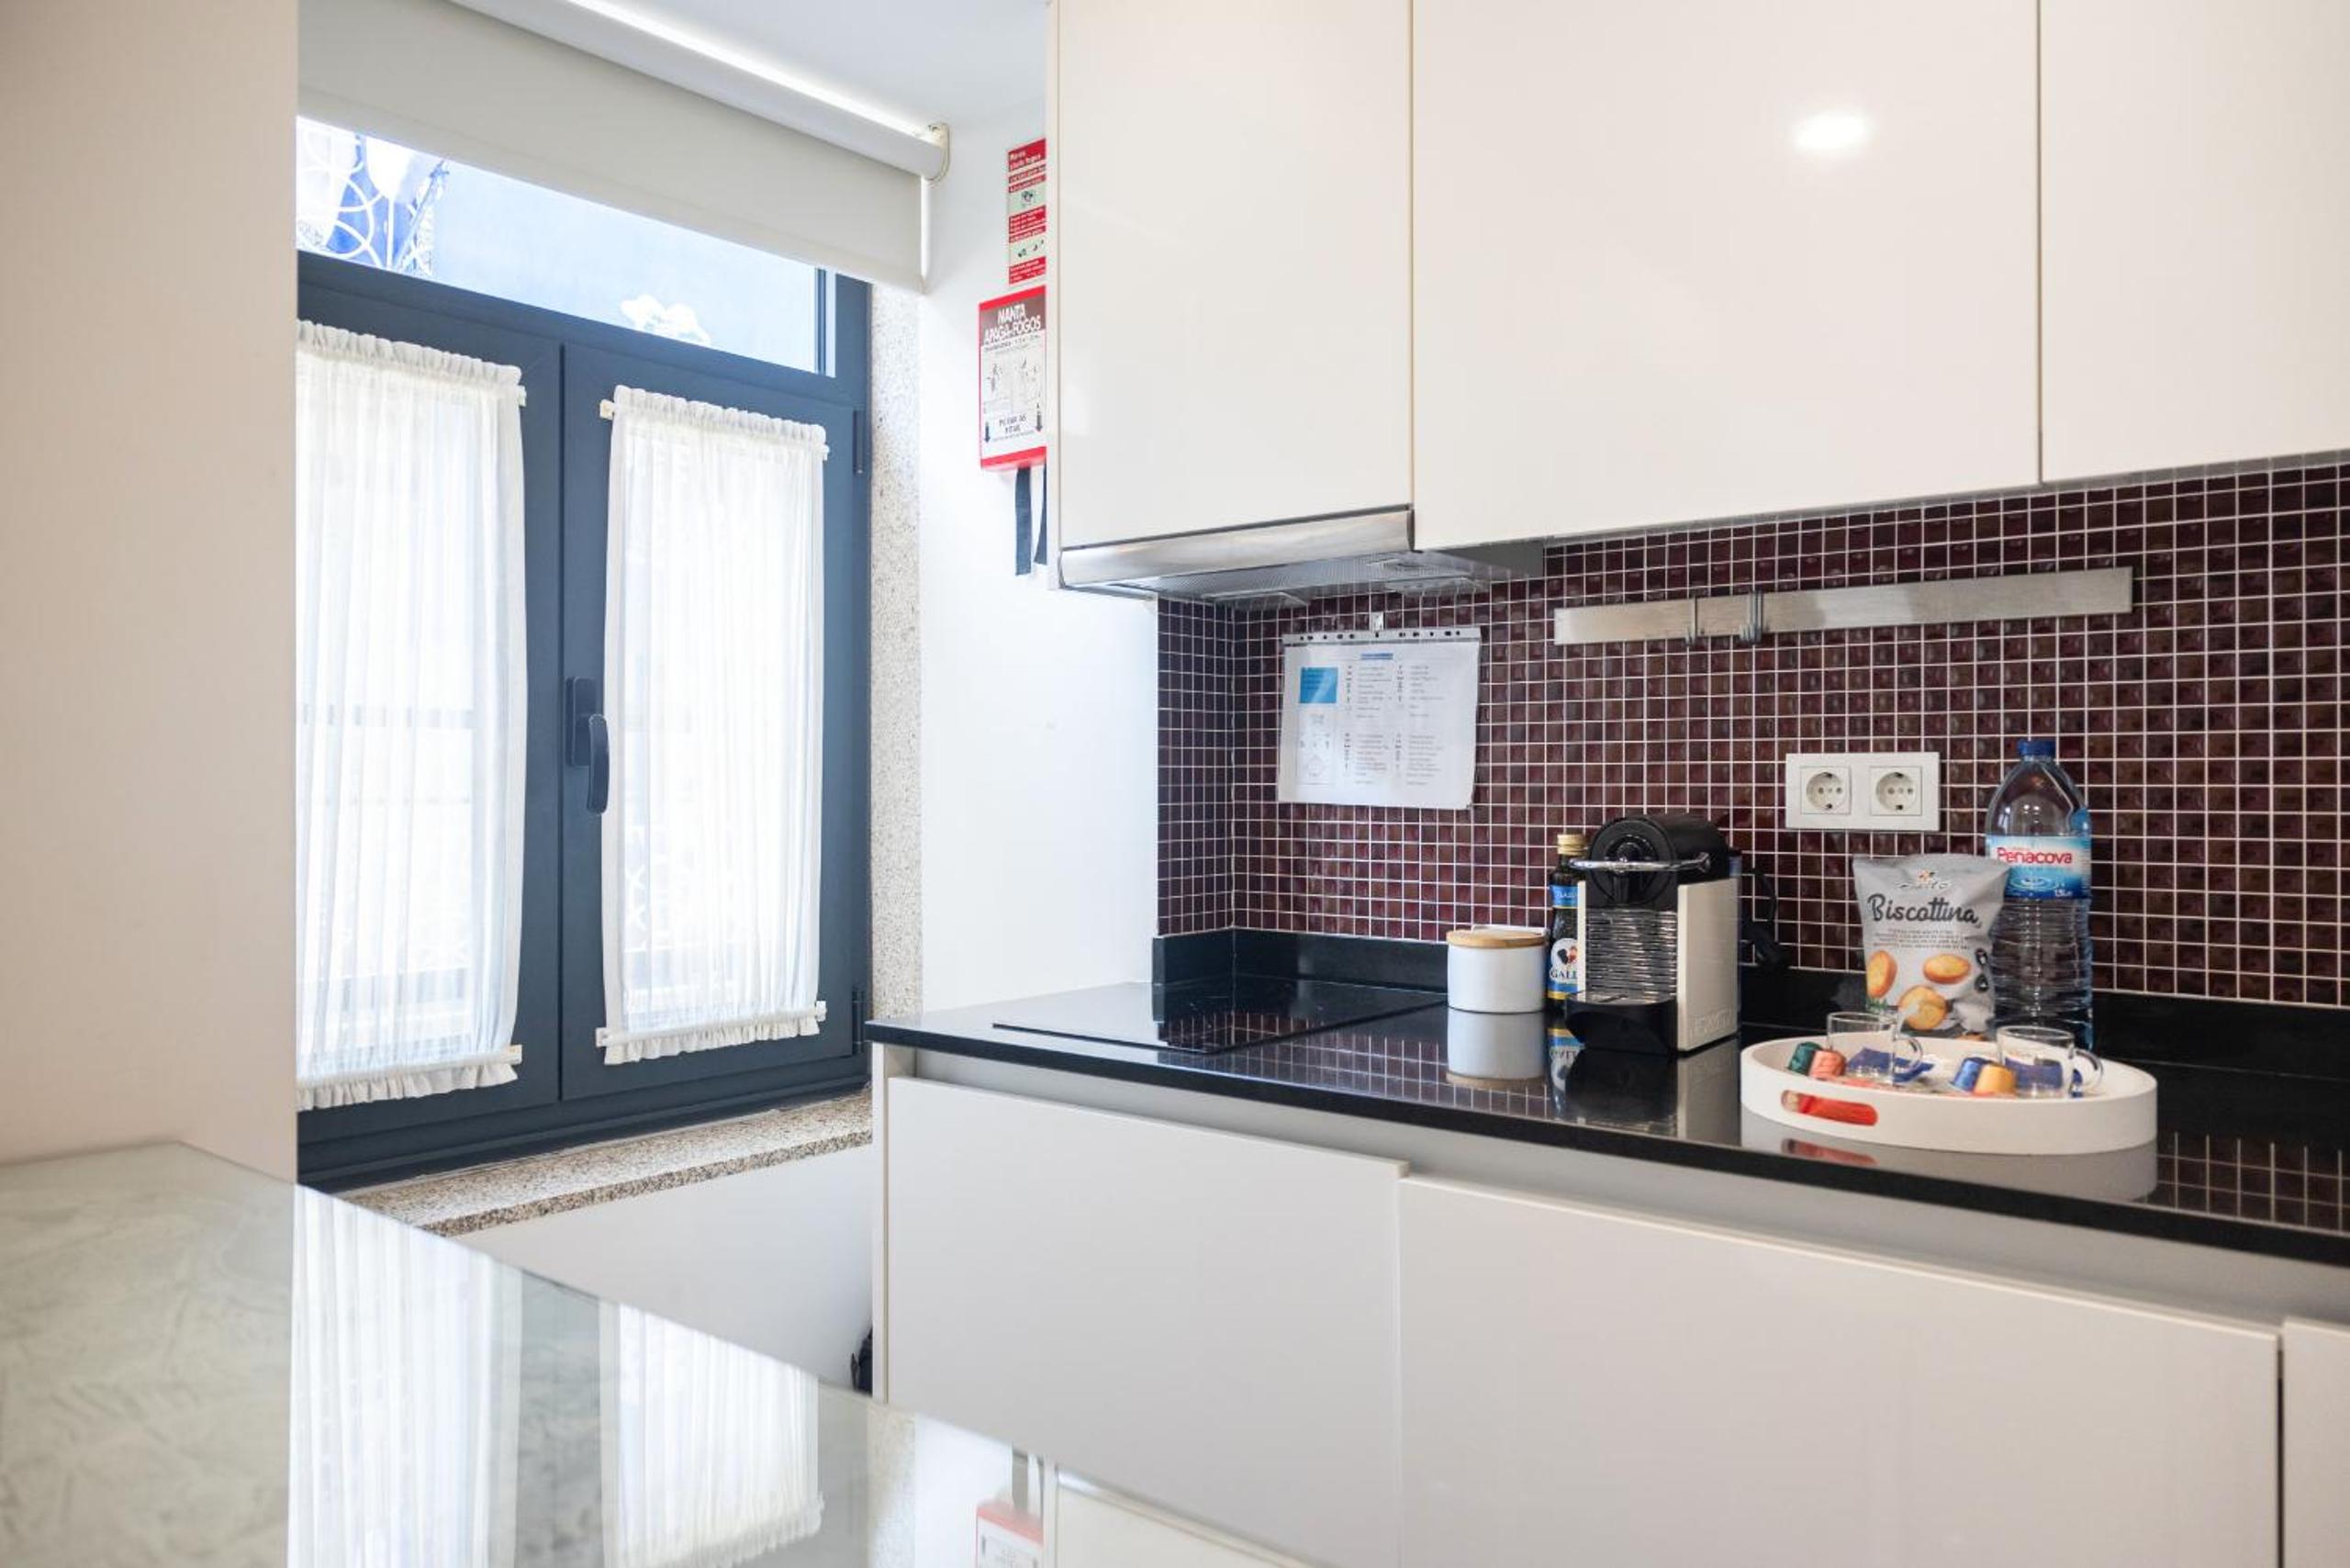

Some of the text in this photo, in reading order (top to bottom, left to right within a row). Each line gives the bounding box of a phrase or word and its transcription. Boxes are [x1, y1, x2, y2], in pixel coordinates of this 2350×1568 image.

[998, 304, 1026, 324] MANTA
[1997, 846, 2073, 864] Penacova
[1867, 893, 1980, 924] Biscottina
[1550, 969, 1577, 980] GALL
